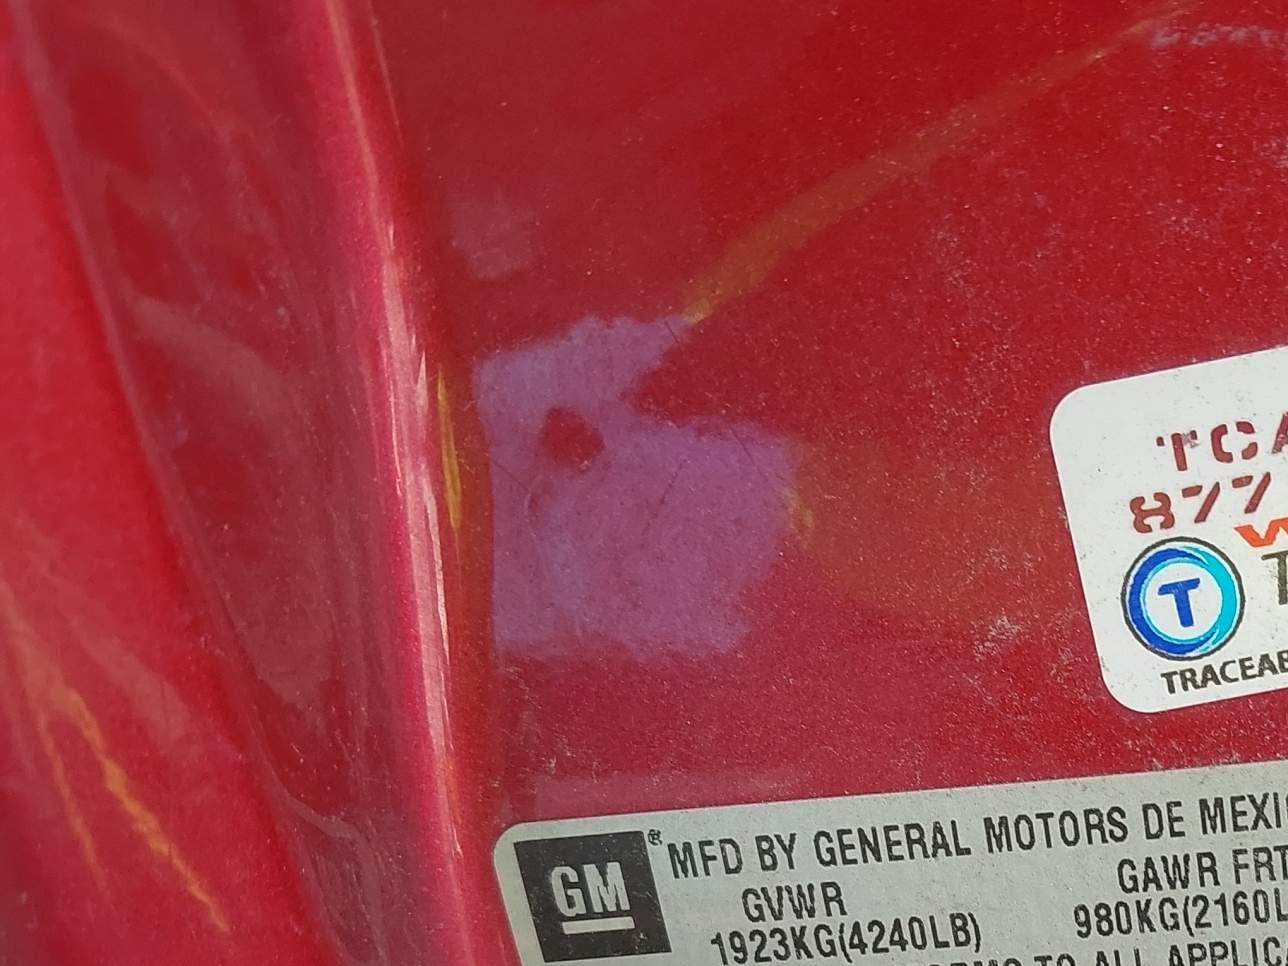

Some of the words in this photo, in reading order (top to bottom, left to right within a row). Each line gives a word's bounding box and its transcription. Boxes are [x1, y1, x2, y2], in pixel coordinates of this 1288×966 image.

[1129, 471, 1275, 533] 877
[668, 836, 744, 879] MFD
[759, 833, 798, 871] BY
[814, 818, 972, 868] GENERAL
[985, 806, 1130, 853] MOTORS
[1143, 800, 1184, 841] DE
[551, 861, 631, 917] GM
[1117, 850, 1221, 894] GAWR
[741, 882, 848, 924] GVWR
[710, 911, 981, 966] 1923KG(4240LB)
